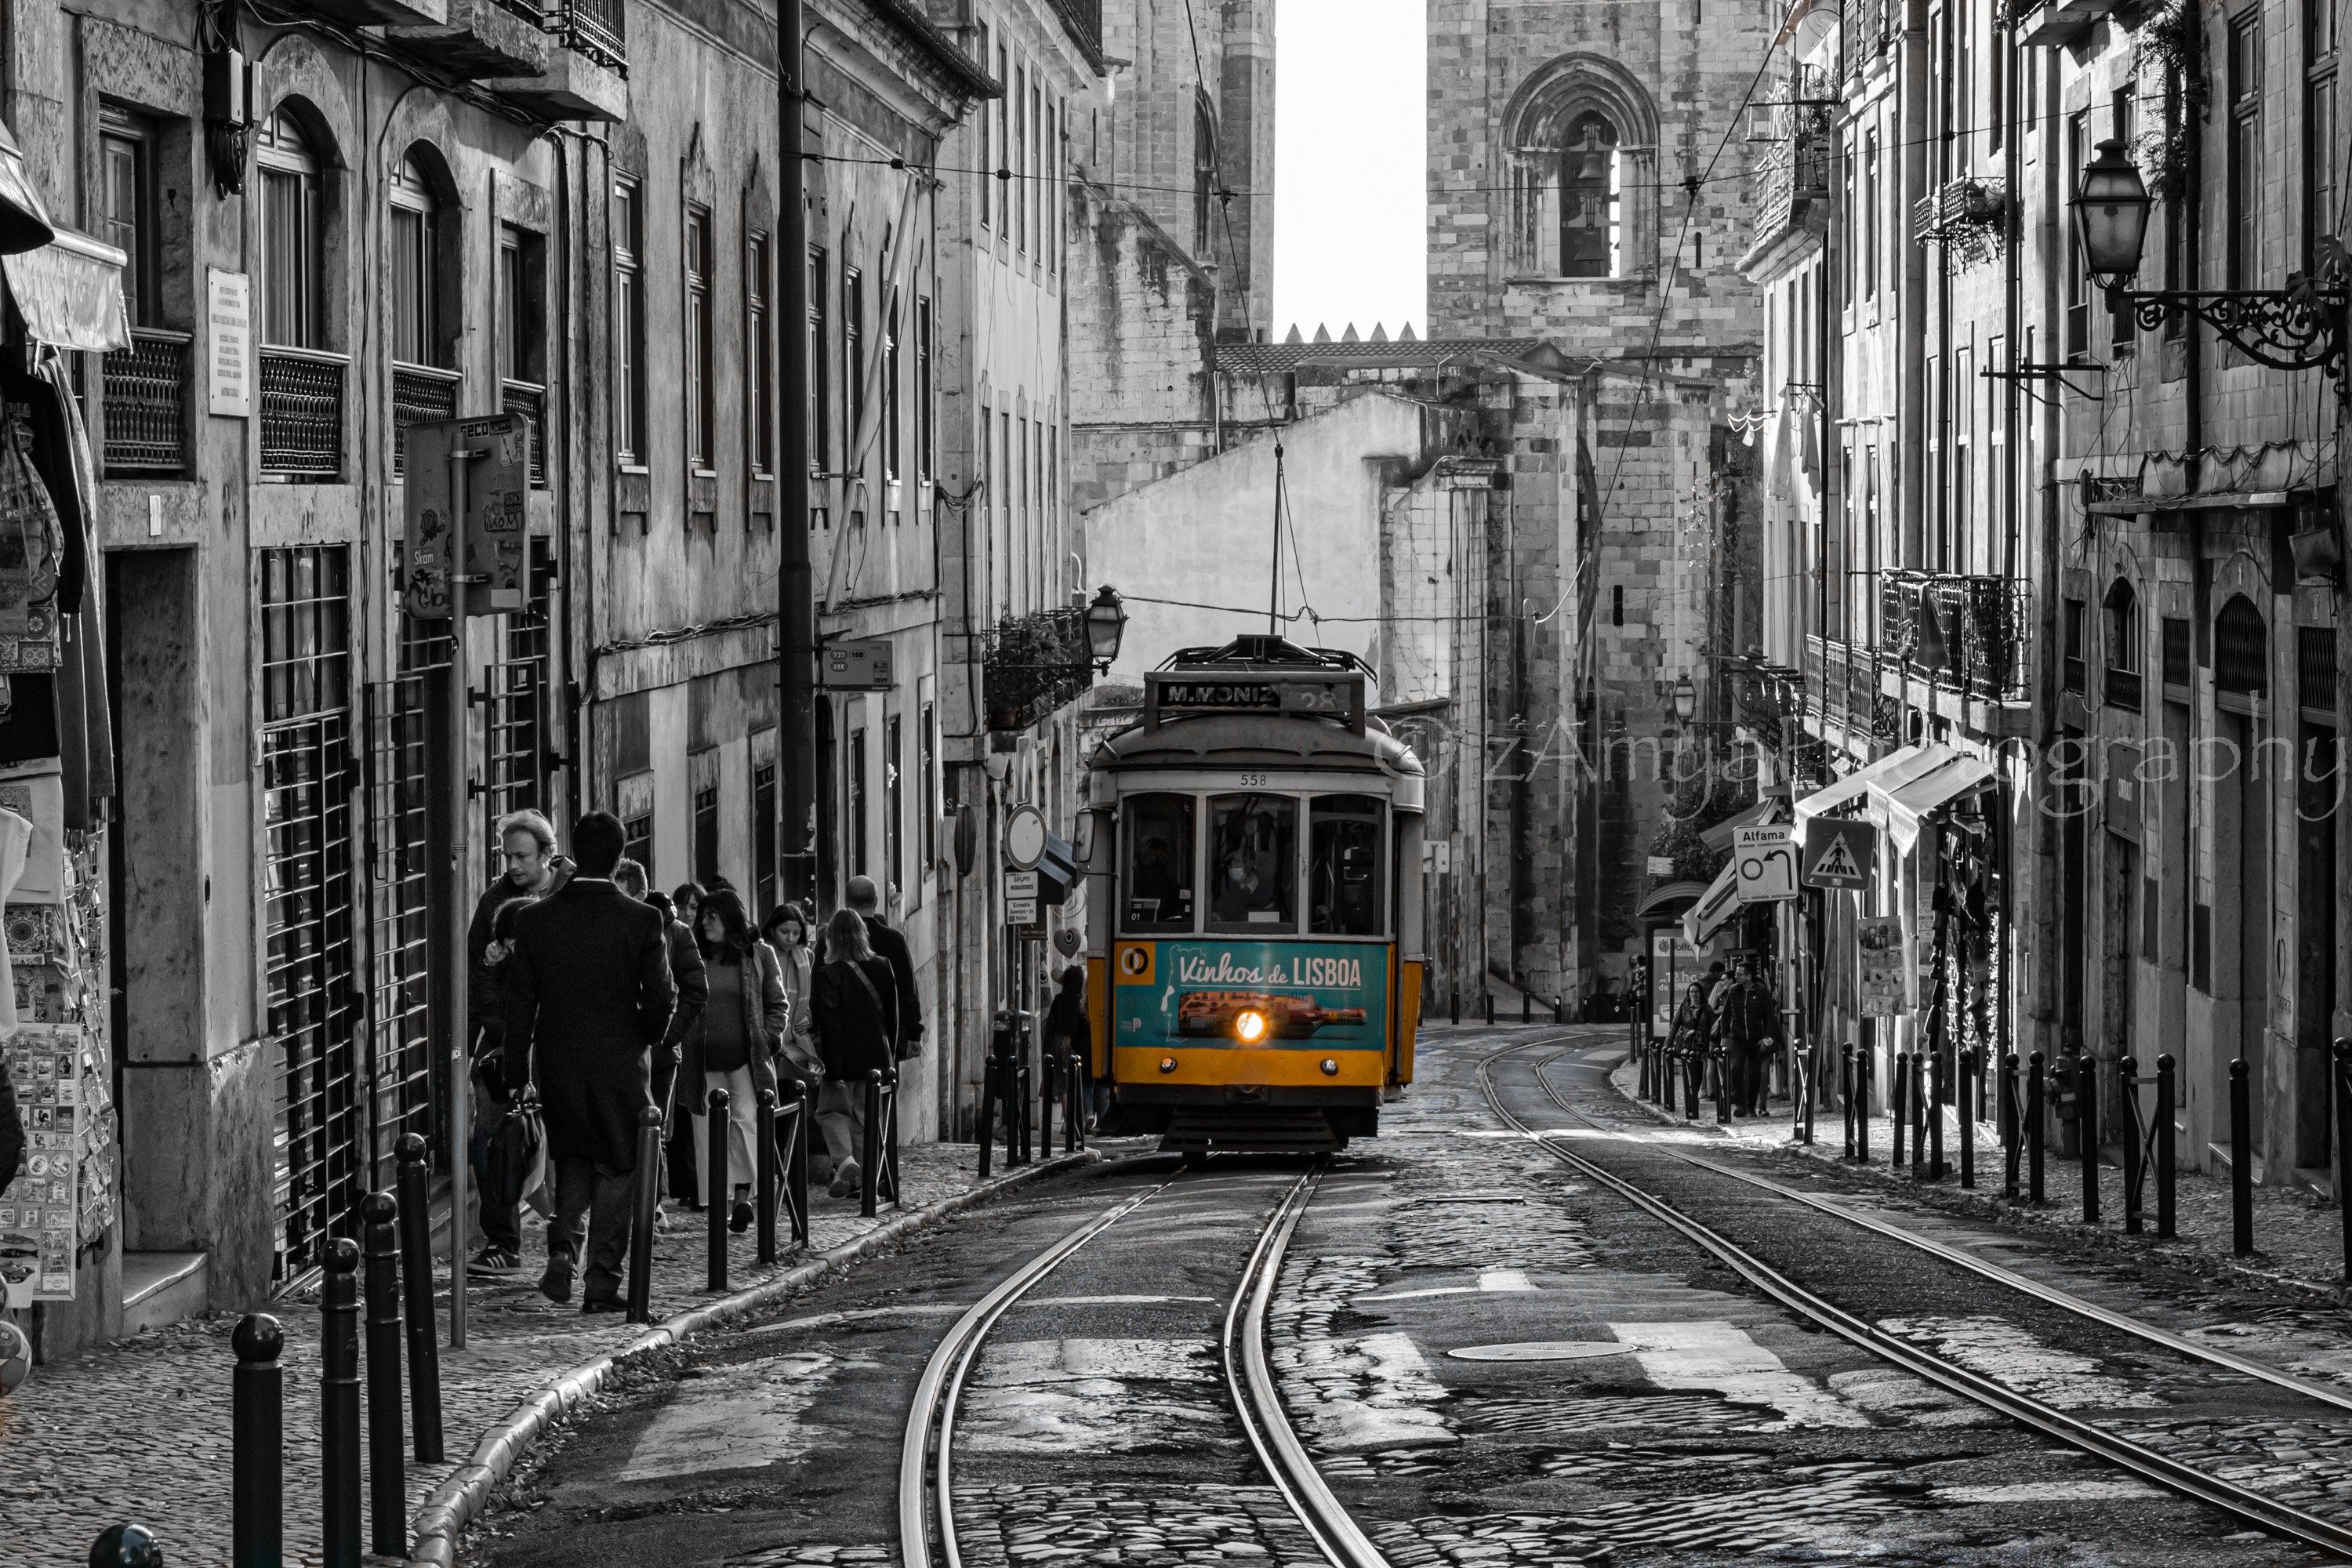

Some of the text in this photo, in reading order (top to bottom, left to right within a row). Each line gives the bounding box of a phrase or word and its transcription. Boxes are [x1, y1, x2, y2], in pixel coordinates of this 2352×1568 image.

[414, 549, 434, 565] Skam
[1168, 686, 1275, 702] M.MONIZ
[1300, 691, 1337, 708] 28
[1240, 775, 1267, 786] 558
[1743, 831, 1785, 842] Alfama
[1131, 913, 1140, 921] 01
[1179, 952, 1361, 987] Vinhos de LISBOA
